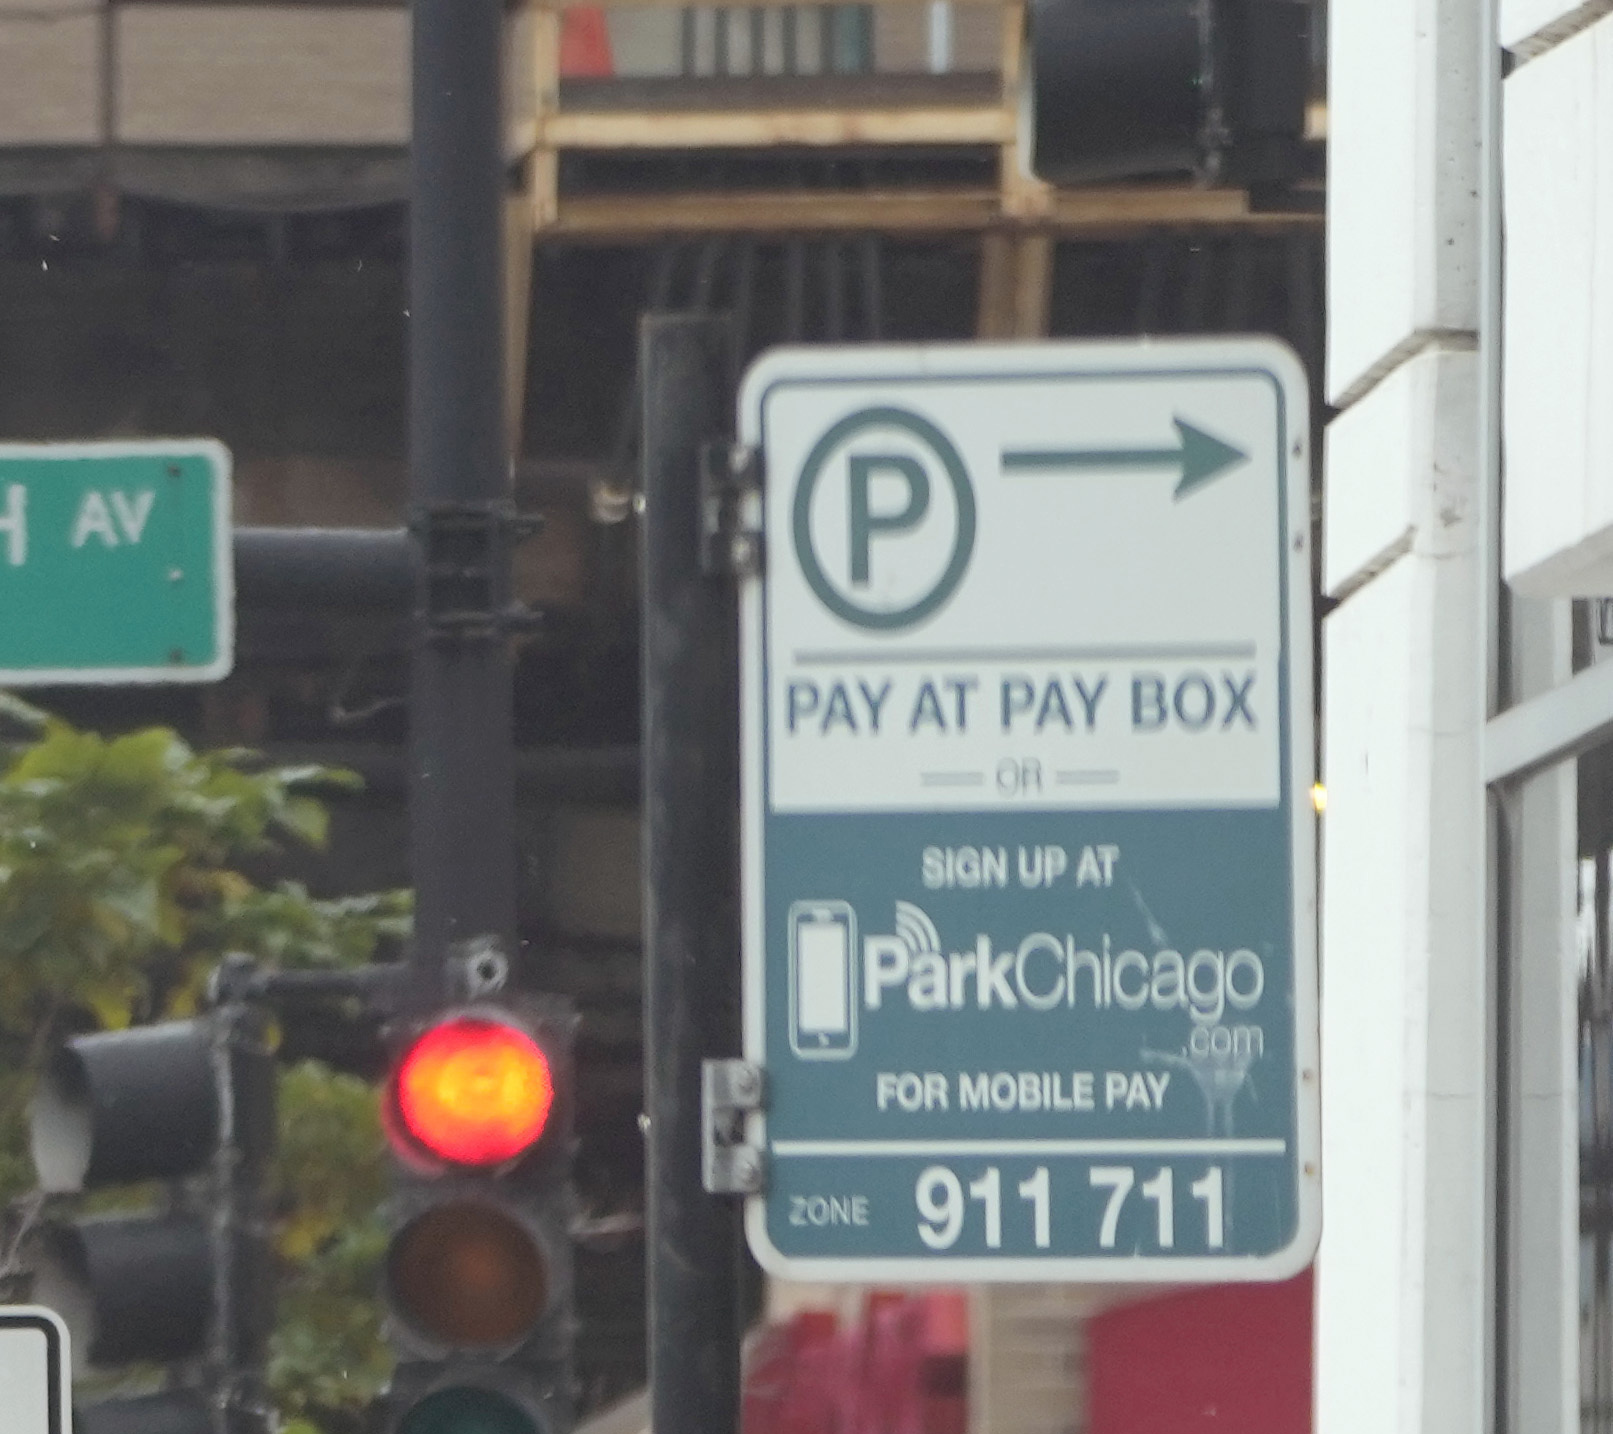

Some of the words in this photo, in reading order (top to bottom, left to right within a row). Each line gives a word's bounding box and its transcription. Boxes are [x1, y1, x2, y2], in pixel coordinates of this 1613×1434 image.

[72, 491, 155, 549] AV
[847, 453, 931, 589] P
[785, 676, 892, 736] PAY
[909, 674, 979, 734] AT
[1000, 672, 1109, 733] PAY
[1131, 669, 1258, 734] BOX
[996, 758, 1043, 796] OR
[921, 845, 1006, 889] SIGN
[1018, 845, 1068, 888] UP
[1077, 844, 1120, 888] AT
[863, 932, 1264, 1024] ParkChicago
[1180, 1024, 1264, 1058] .com
[877, 1072, 948, 1111] FOR
[959, 1072, 1095, 1111] MOBILE
[1105, 1071, 1171, 1110] PAY
[788, 1195, 869, 1226] ZONE
[915, 1165, 1051, 1249] 911
[1089, 1165, 1225, 1248] 711
